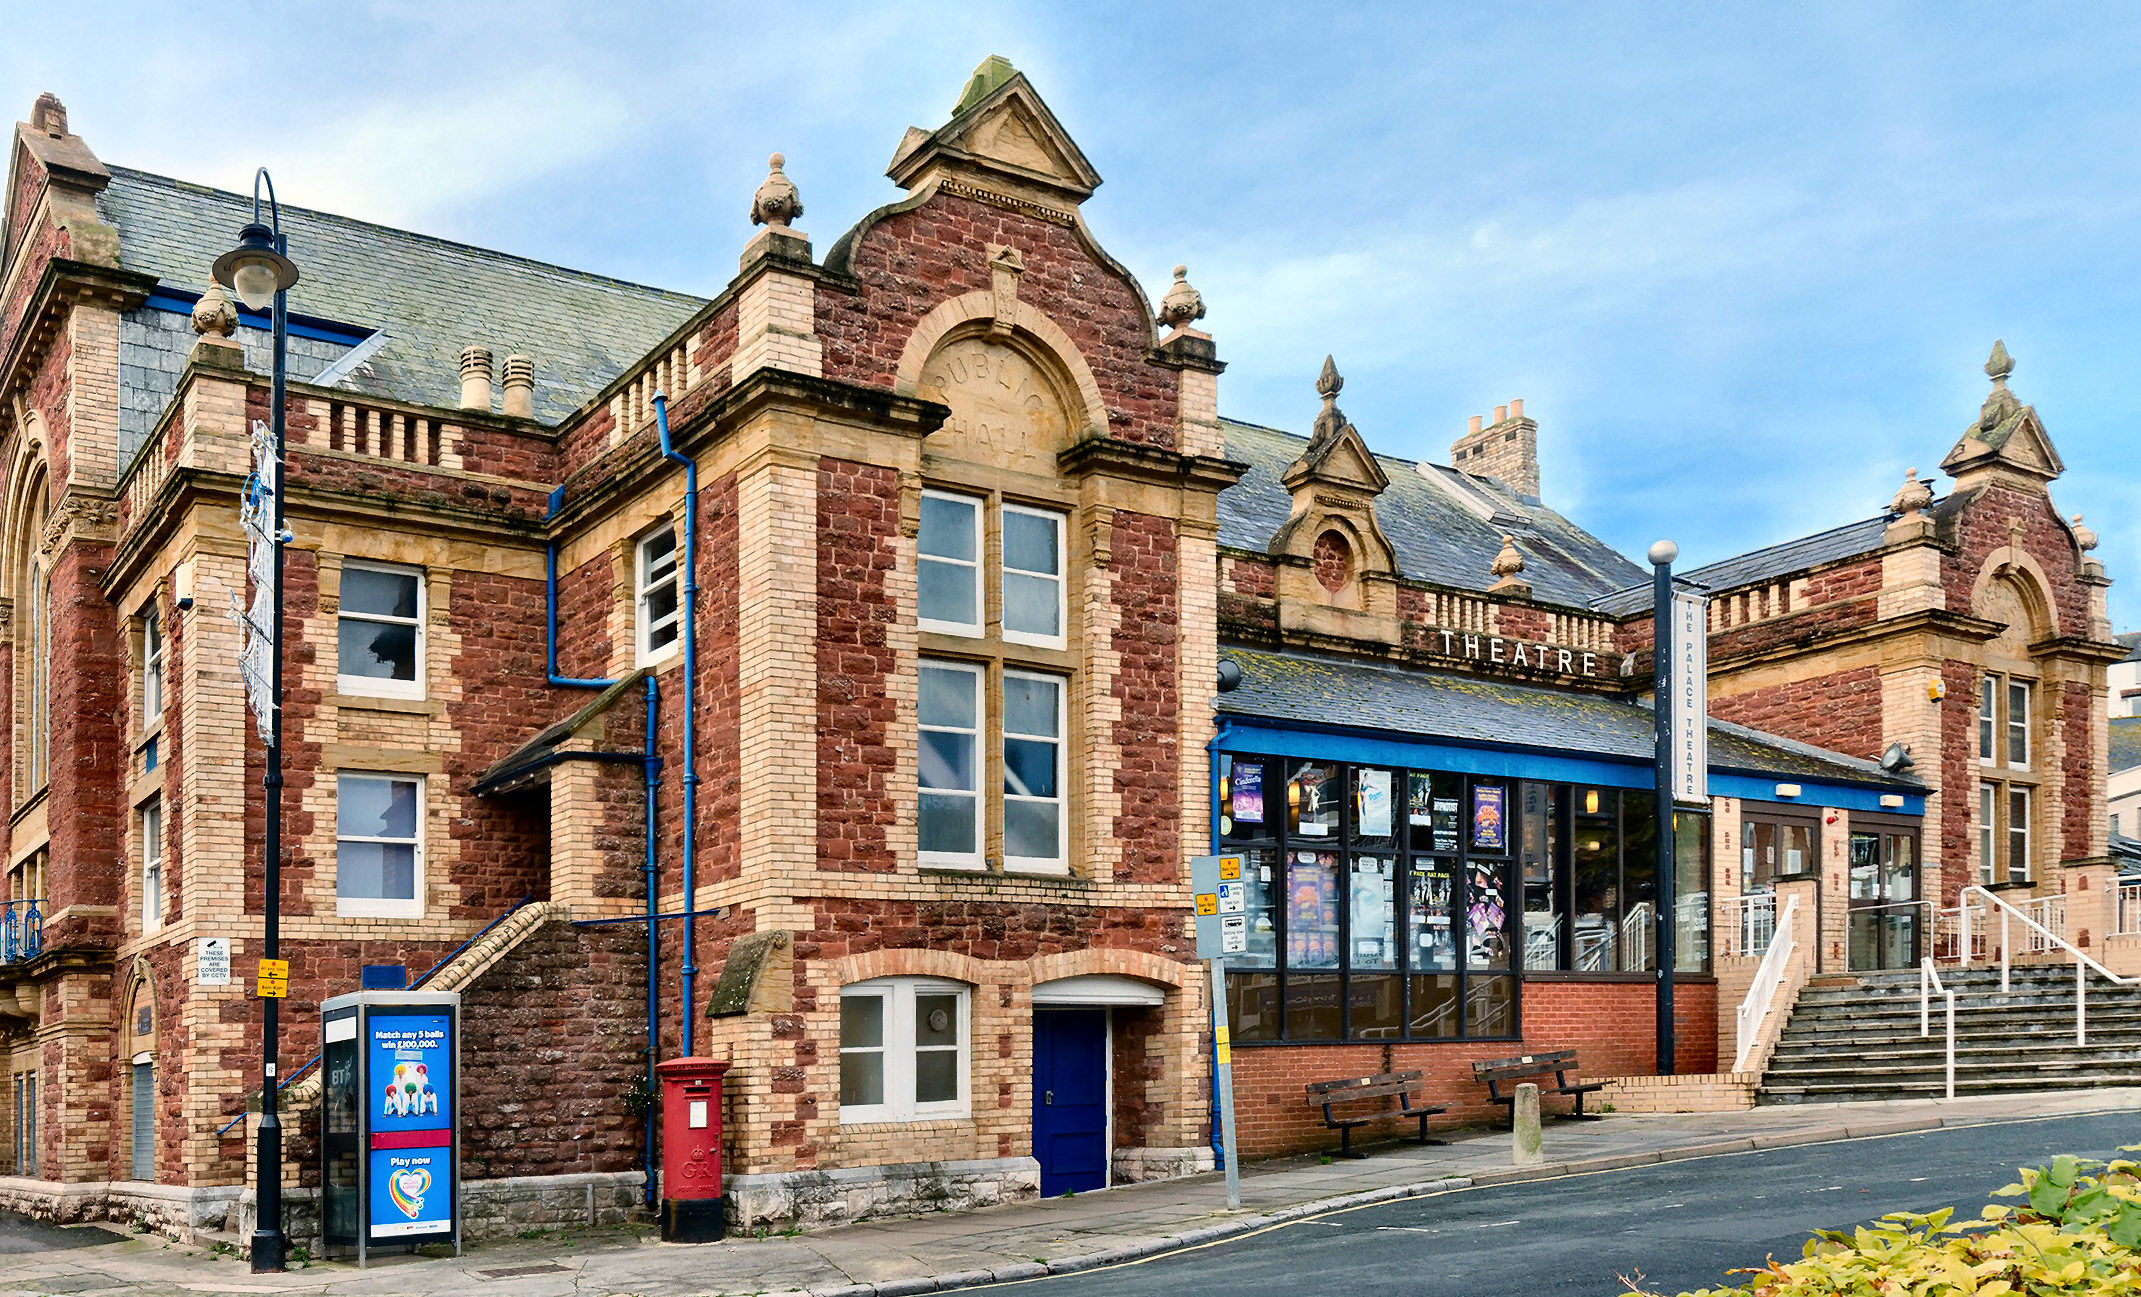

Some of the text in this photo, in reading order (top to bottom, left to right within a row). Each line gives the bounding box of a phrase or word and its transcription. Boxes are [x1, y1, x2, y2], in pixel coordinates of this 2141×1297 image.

[949, 417, 1037, 459] HALL
[1439, 629, 1597, 677] THEATRE
[1685, 600, 1694, 795] THE PALACE THEATRE
[375, 1030, 445, 1040] Match any 5 balls
[381, 1040, 439, 1050] win £100,000.
[331, 1069, 345, 1085] BT
[390, 1157, 431, 1168] Play now
[681, 1162, 712, 1179] GR
